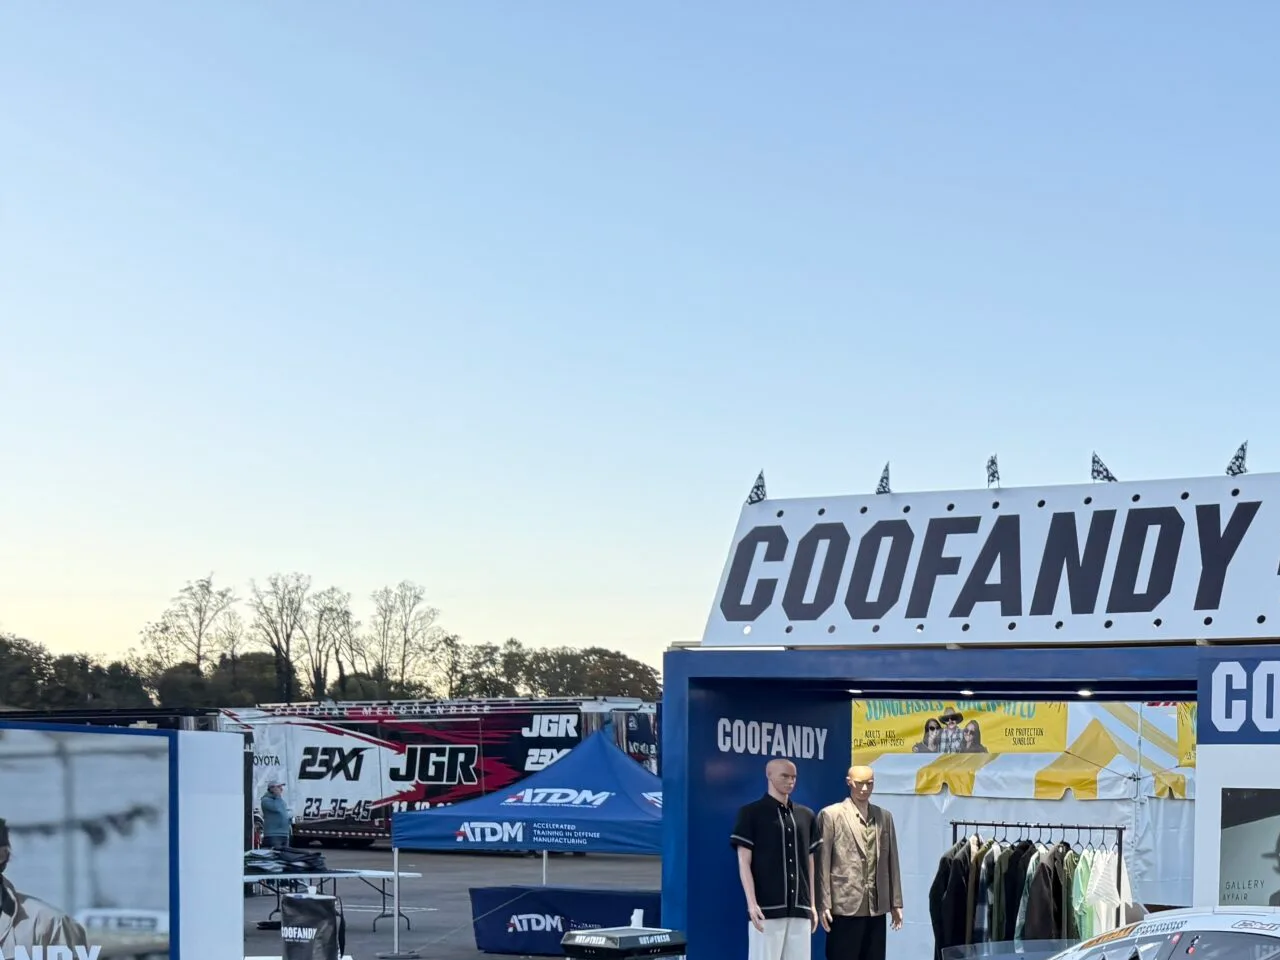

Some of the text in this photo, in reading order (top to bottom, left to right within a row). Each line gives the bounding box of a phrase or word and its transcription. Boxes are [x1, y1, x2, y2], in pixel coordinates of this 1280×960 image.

[719, 501, 1262, 622] COOFANDY
[521, 714, 579, 737] JGR
[717, 718, 827, 760] COOFANDY
[253, 755, 281, 766] OYOTA
[389, 745, 478, 785] JGR
[503, 788, 609, 805] ATDM
[456, 821, 524, 842] ATDM
[533, 822, 577, 831] ACCELERATED
[532, 836, 588, 845] MANUFACTURING
[1225, 880, 1265, 890] GALLERY
[507, 913, 563, 932] ATDM
